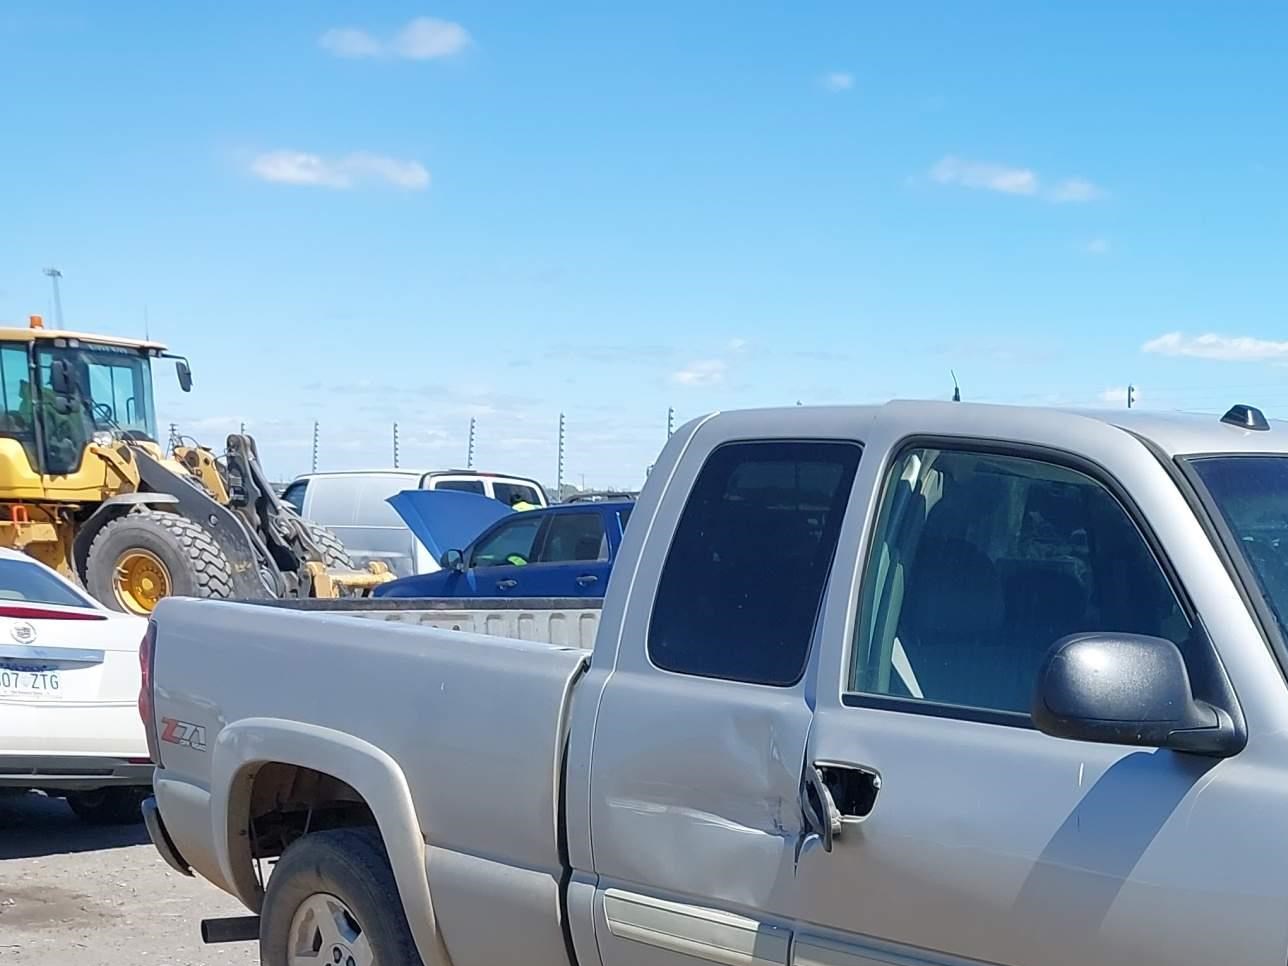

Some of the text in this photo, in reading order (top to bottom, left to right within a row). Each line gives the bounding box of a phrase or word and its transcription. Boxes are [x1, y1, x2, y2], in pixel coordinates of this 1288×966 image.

[0, 672, 59, 690] 07 ZTG
[161, 716, 207, 747] Z71
